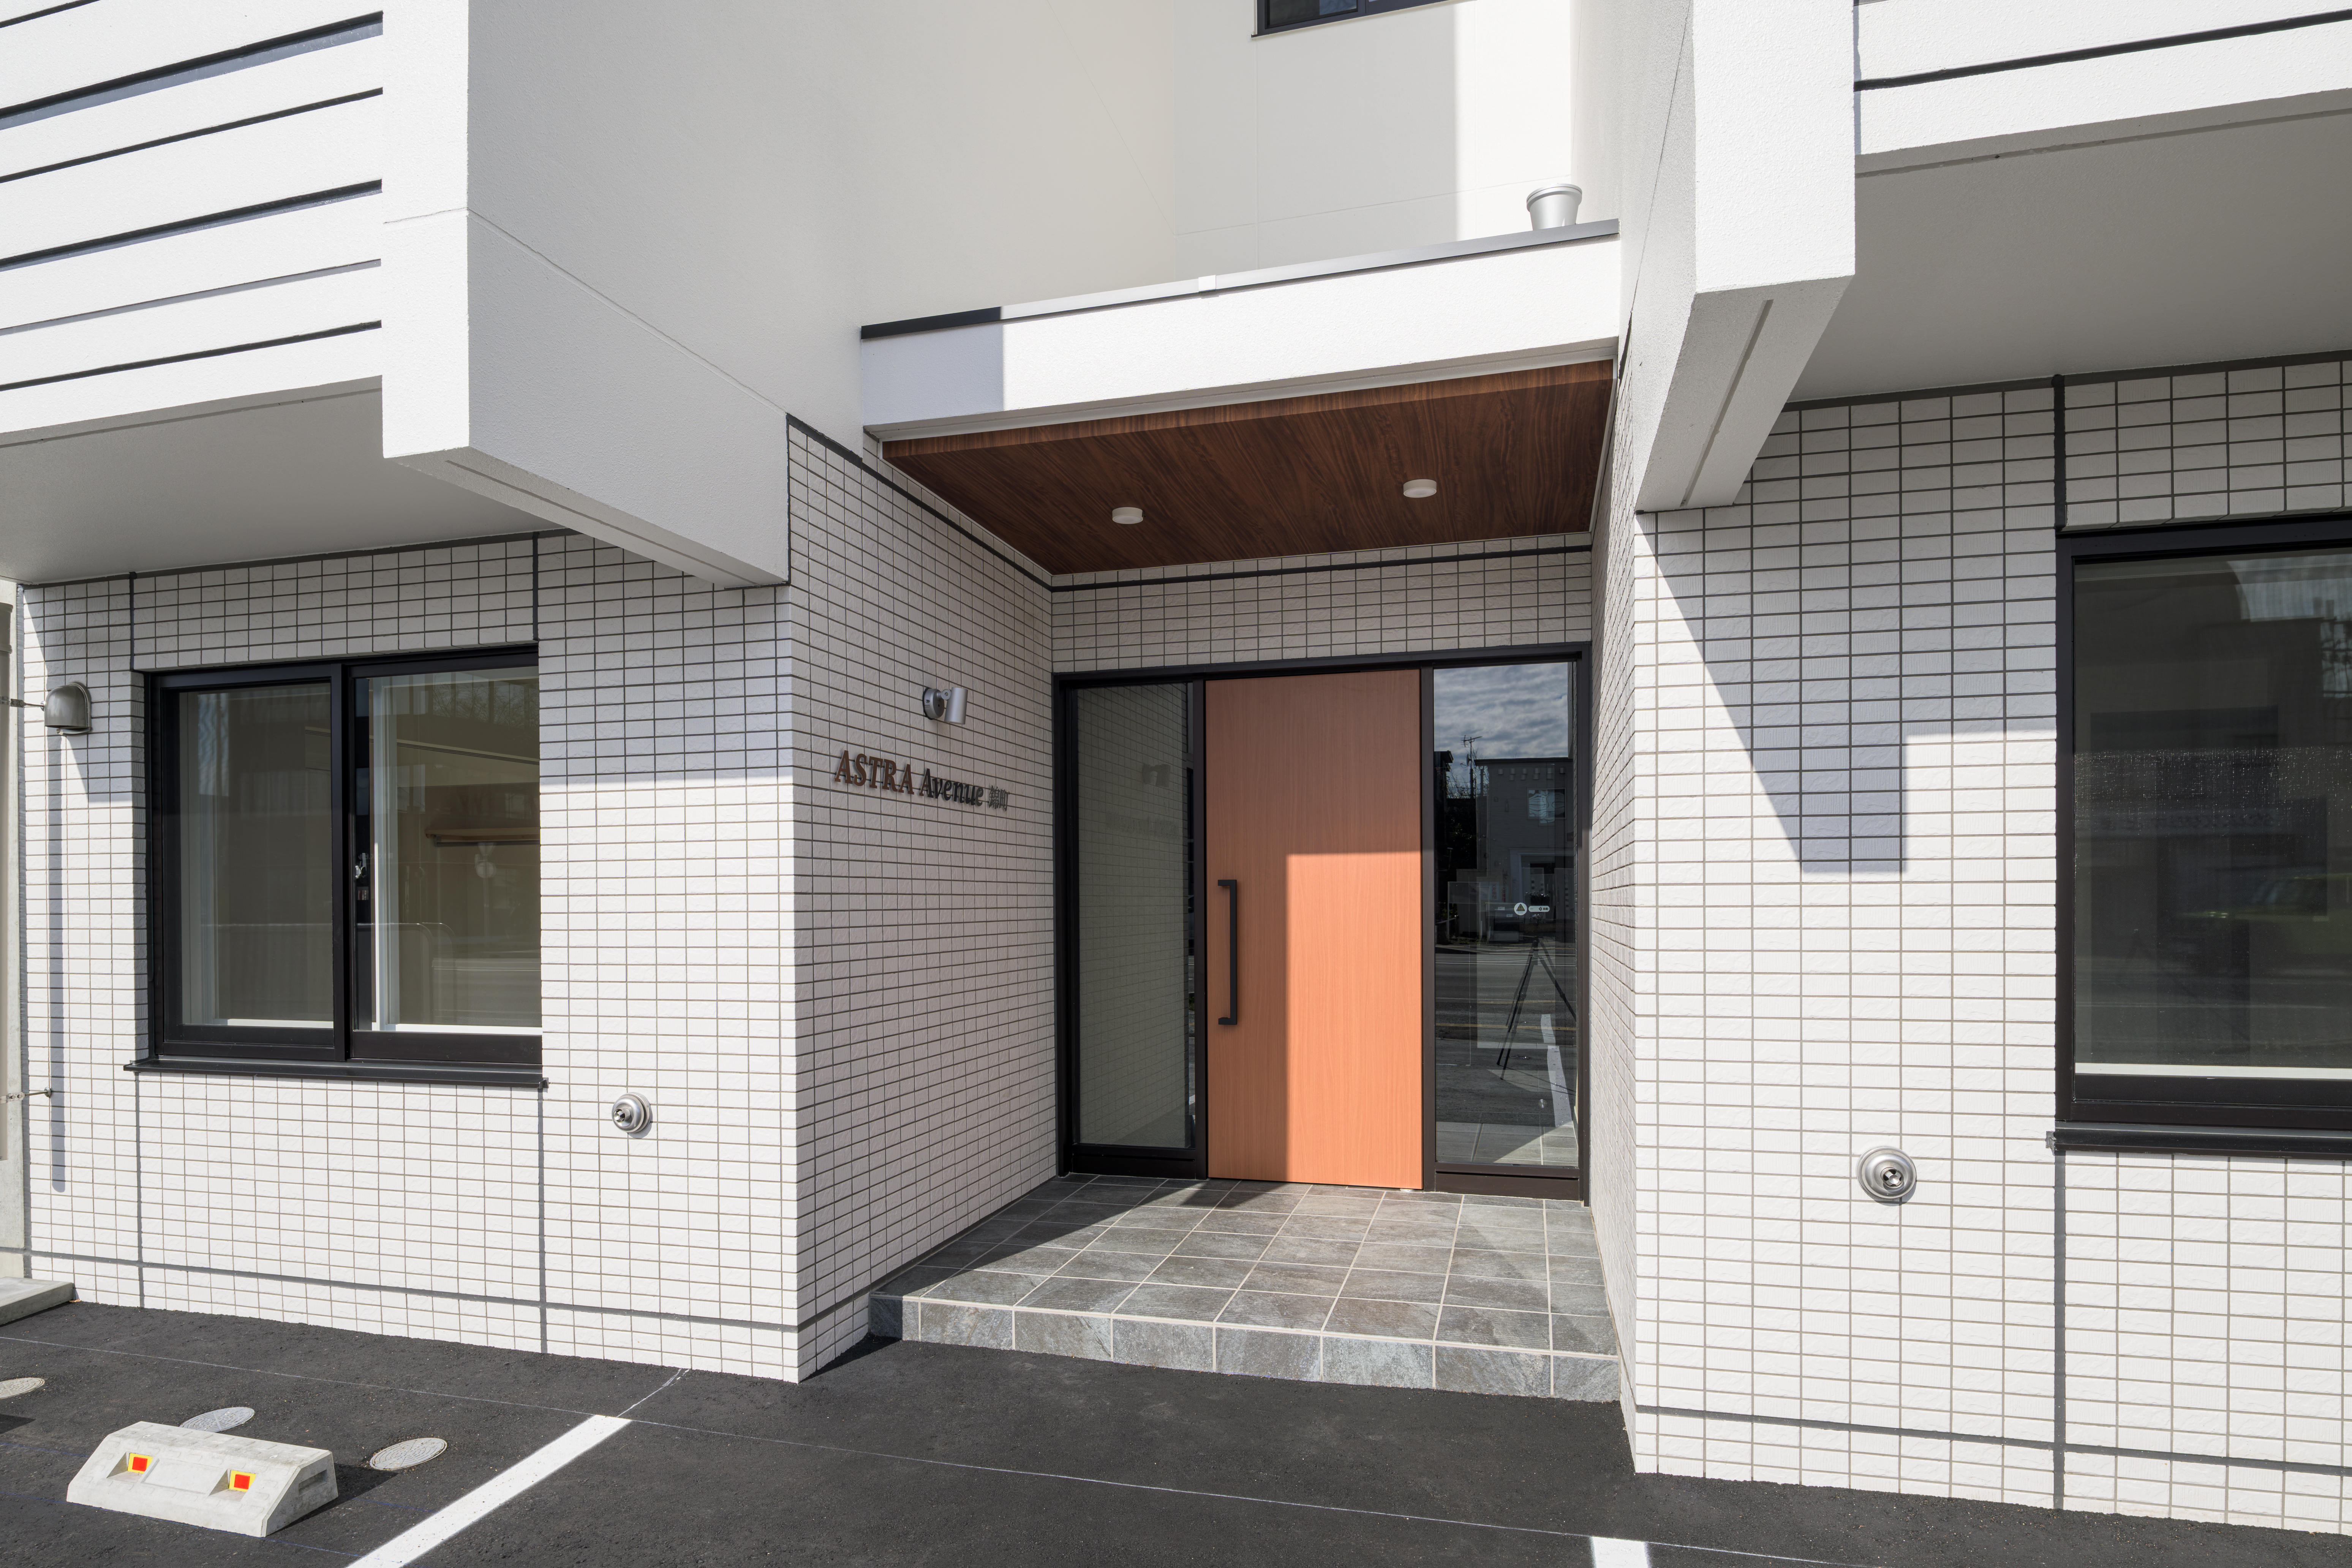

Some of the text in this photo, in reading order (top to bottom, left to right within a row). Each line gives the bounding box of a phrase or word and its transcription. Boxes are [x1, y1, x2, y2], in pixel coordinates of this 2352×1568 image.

[835, 750, 1010, 811] ASTRA Avenue 錦町
